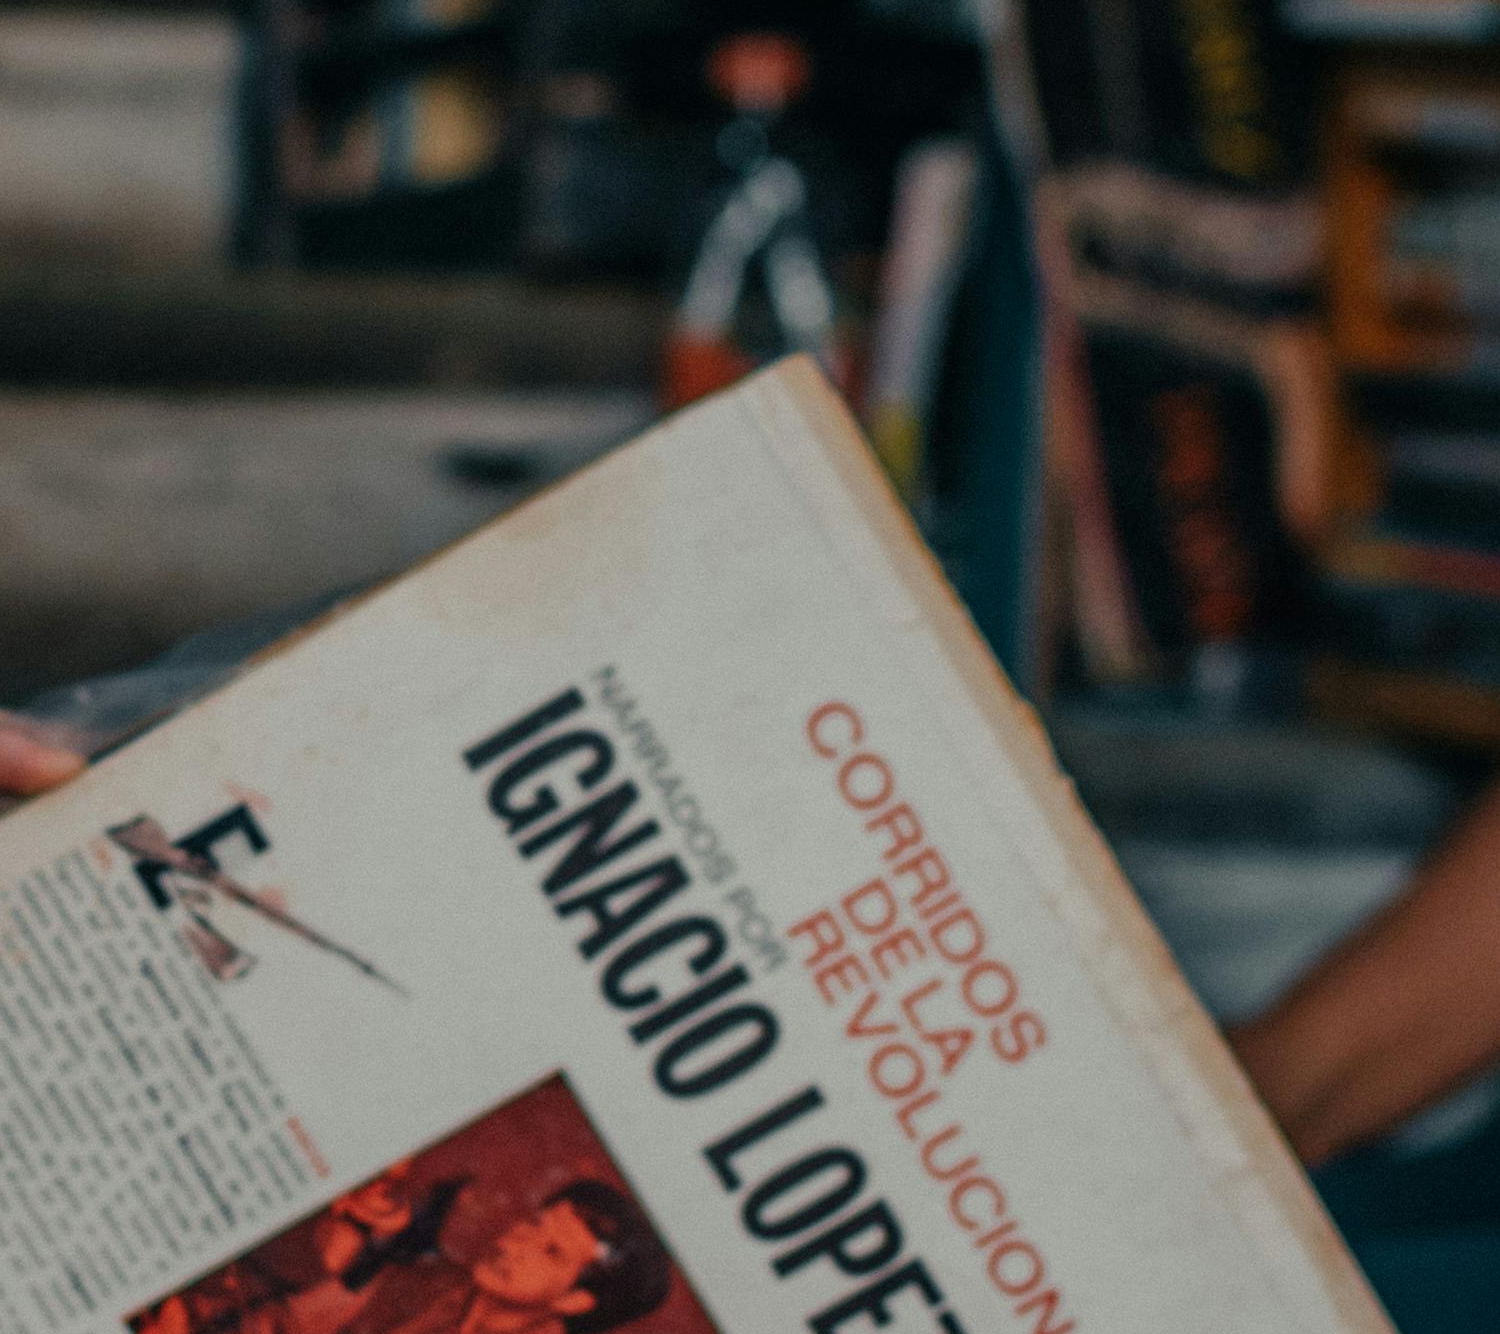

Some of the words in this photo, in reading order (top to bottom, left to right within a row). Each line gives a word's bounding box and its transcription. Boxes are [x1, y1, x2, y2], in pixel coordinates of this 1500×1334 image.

[463, 688, 780, 1099] IGNACIO
[592, 665, 734, 883] NARRADOS
[724, 887, 788, 972] POR
[806, 702, 1045, 1063] CORRIDOS
[841, 877, 926, 978] DE
[900, 979, 975, 1075] LA
